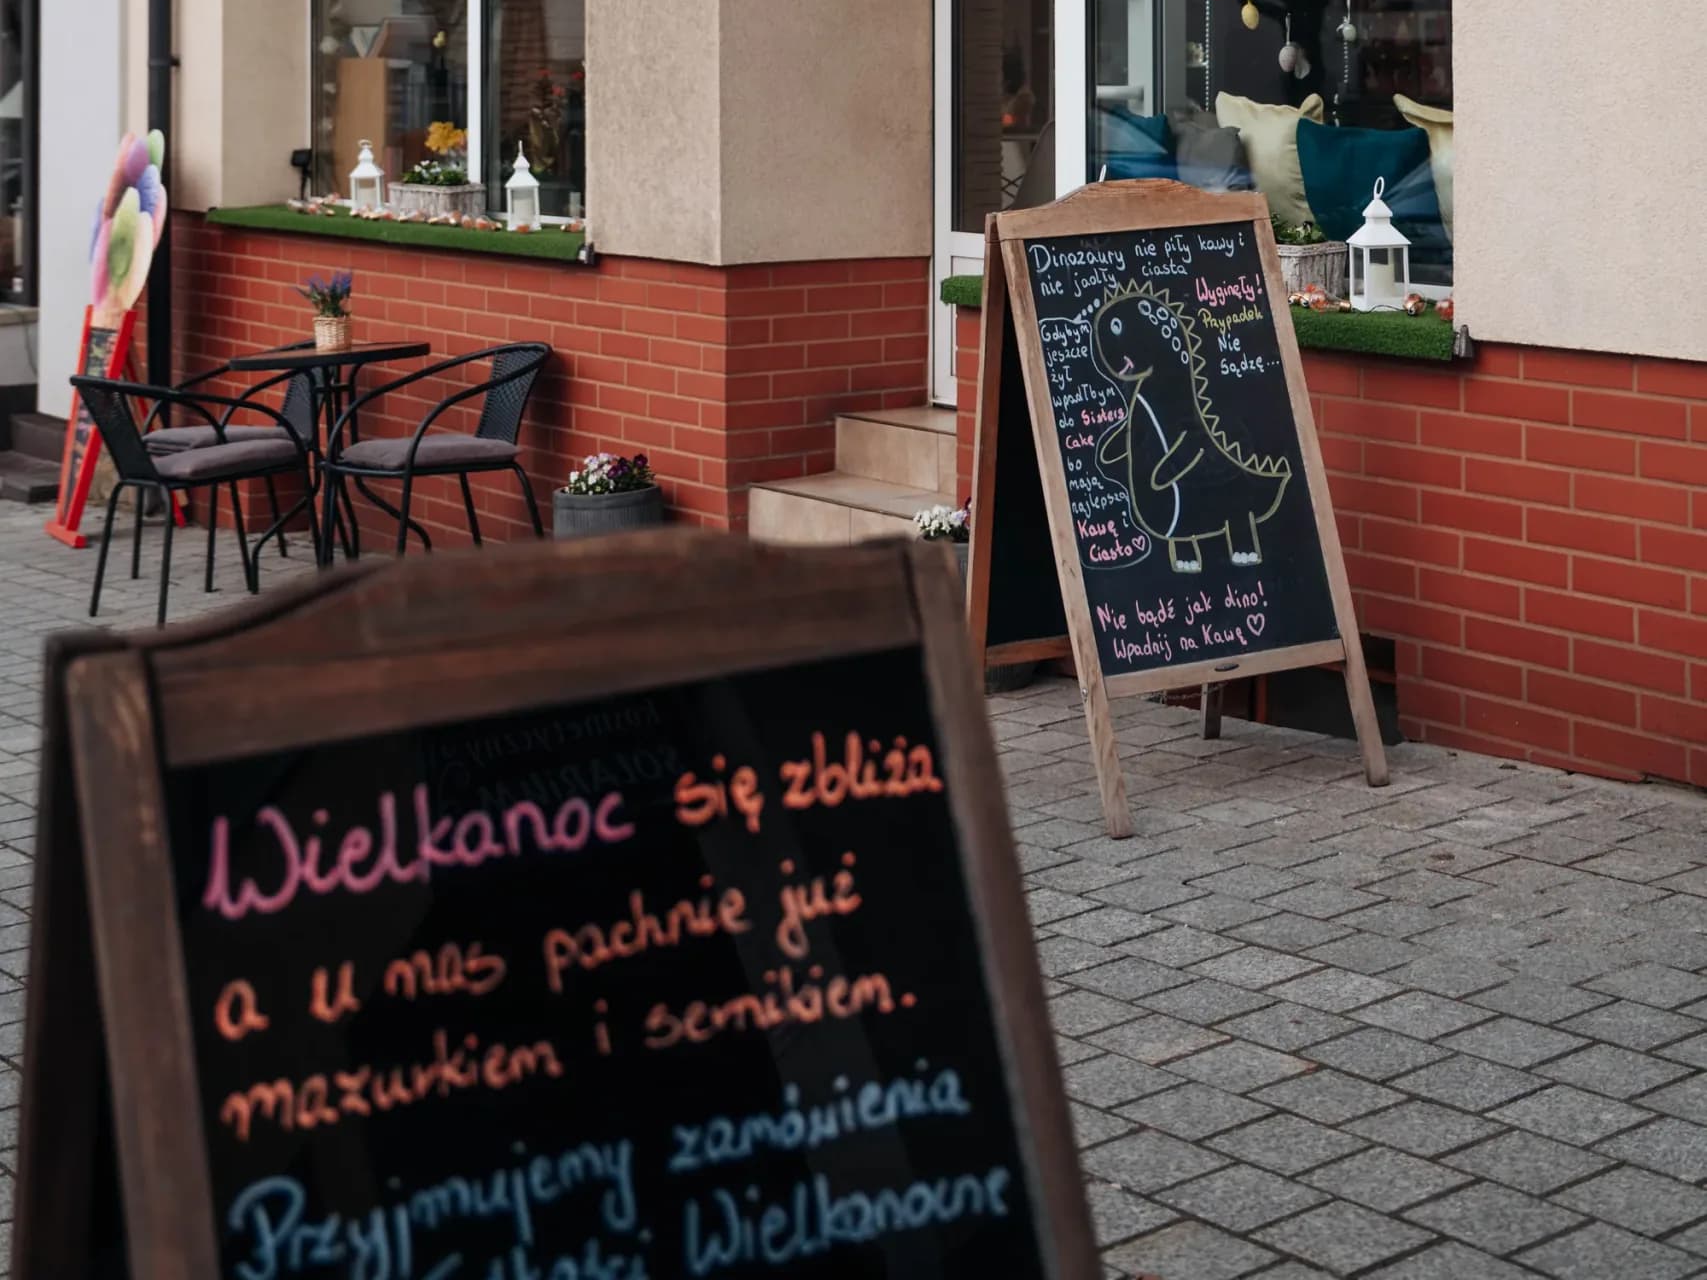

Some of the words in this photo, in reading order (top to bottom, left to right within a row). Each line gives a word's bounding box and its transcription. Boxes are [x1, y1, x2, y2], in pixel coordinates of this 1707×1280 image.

[1029, 243, 1125, 273] Dinozaury
[1135, 243, 1157, 257] nie
[1164, 234, 1192, 263] piły
[1198, 234, 1235, 257] kawy
[1040, 274, 1064, 297] nie
[1073, 267, 1117, 297] jadły
[1141, 258, 1188, 277] ciasta
[1040, 323, 1090, 347] Gdybym
[1217, 333, 1240, 352] Nie
[1051, 365, 1073, 390] żył
[1058, 412, 1075, 428] do
[1081, 408, 1125, 426] Sisters
[1065, 433, 1095, 449] Cake
[1067, 456, 1082, 471] bo
[1069, 472, 1104, 492] mają
[1071, 491, 1129, 519] najlepszą
[1077, 520, 1119, 539] Kawę
[1089, 539, 1133, 562] Ciasto
[1096, 602, 1127, 632] Nie
[1135, 599, 1176, 628] bądź
[1184, 591, 1212, 625] jak
[1112, 631, 1172, 665] Wpadnij
[1179, 636, 1199, 651] na
[1202, 623, 1248, 646] Kawę
[203, 782, 636, 921] Wielkanoc
[674, 753, 765, 833] się
[779, 730, 944, 808] zbliża
[213, 977, 271, 1042] a
[308, 959, 362, 1023] u
[382, 940, 507, 1001] nas
[543, 888, 752, 995] pachnie
[776, 850, 862, 959] już
[219, 1027, 565, 1143] mazurkiem
[594, 998, 612, 1056] i
[227, 1138, 636, 1280] Przyjmujemy
[668, 1057, 971, 1173] zamówienia
[682, 1164, 1011, 1278] Wielkanocne
